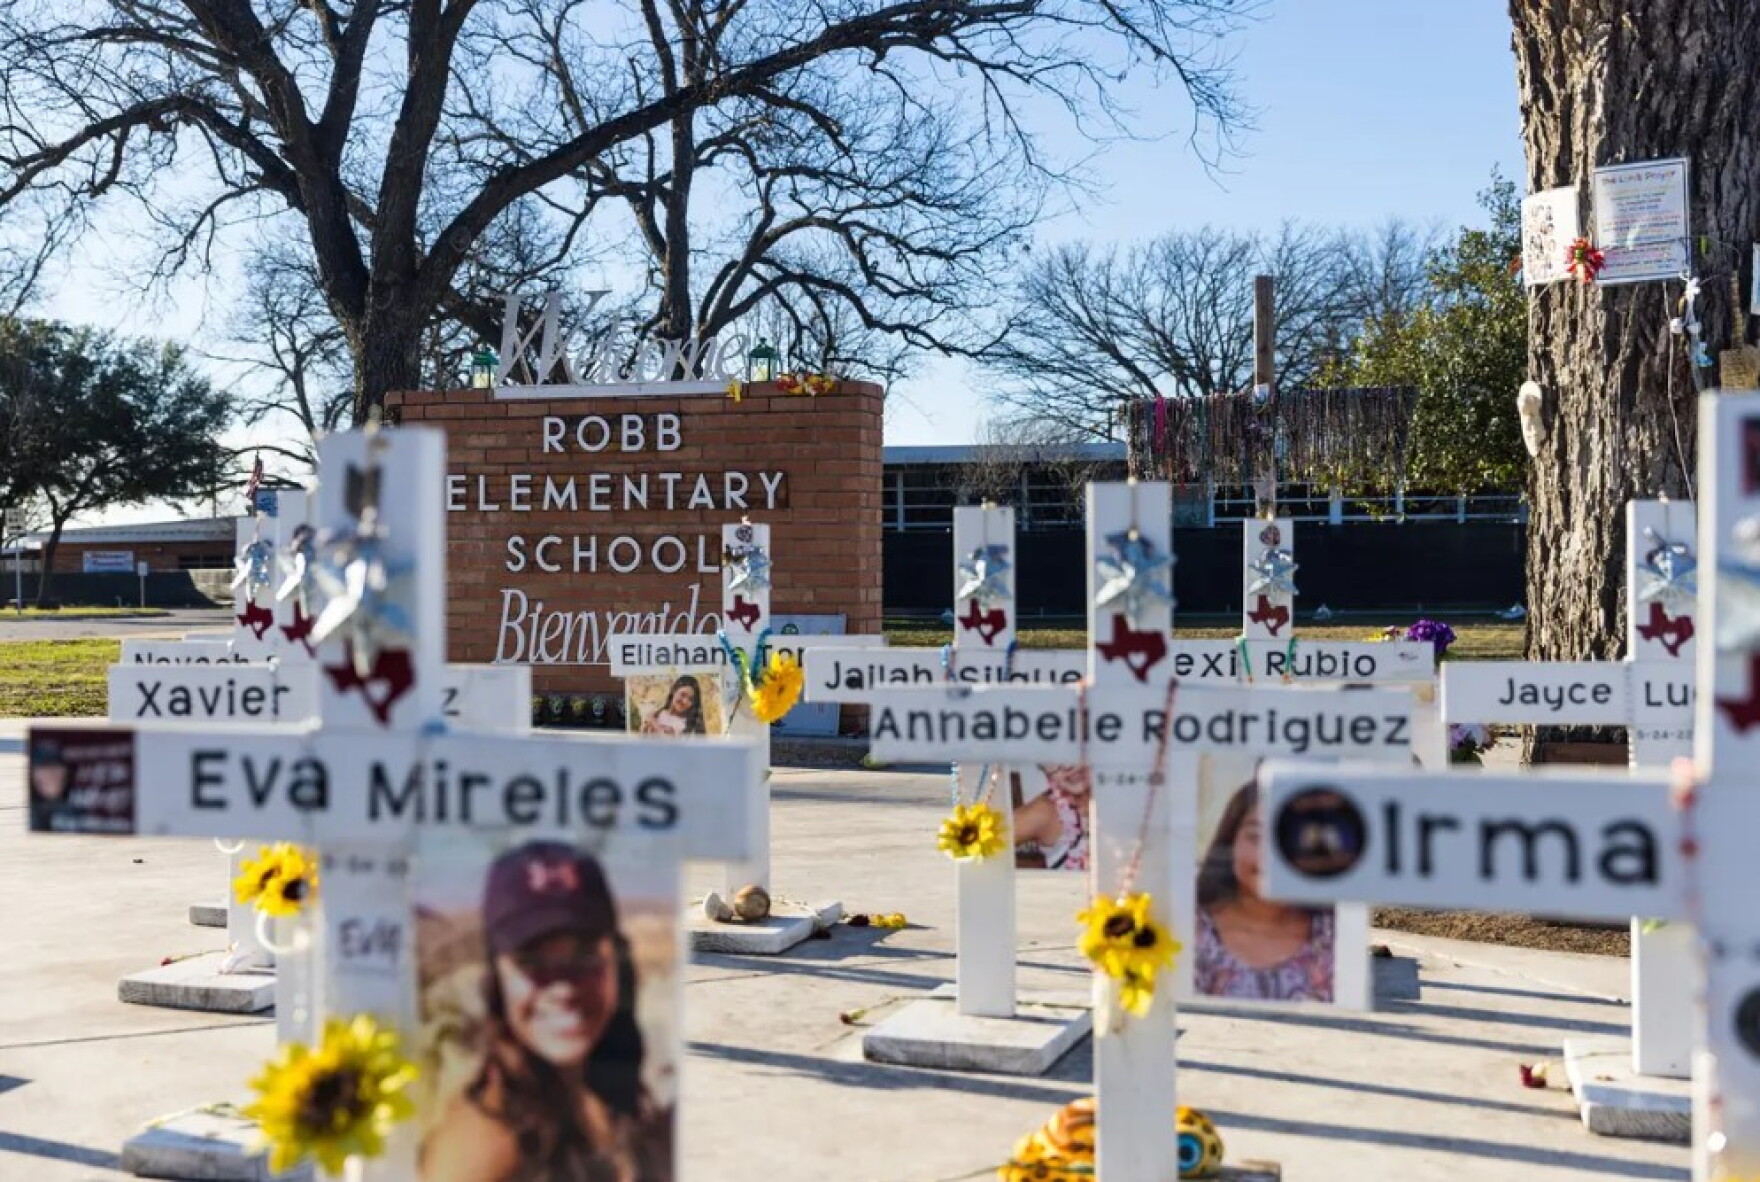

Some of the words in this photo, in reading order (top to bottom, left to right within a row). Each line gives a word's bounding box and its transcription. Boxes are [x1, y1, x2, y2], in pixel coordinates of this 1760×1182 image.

[496, 289, 751, 385] Welcome
[543, 413, 682, 453] ROBB
[446, 472, 785, 511] ELEMENTARY
[506, 535, 720, 573] SCHOOL
[622, 644, 743, 666] Eliahan
[1174, 649, 1237, 677] exi
[1266, 650, 1376, 677] Rubio
[136, 679, 291, 717] Xavier
[1499, 677, 1612, 712] Jayce
[1645, 681, 1697, 708] Lu
[874, 706, 1123, 743] Annabelle
[1142, 710, 1409, 753] Rodriguez
[190, 748, 331, 812] Eva
[367, 760, 680, 831] Mireles
[1381, 800, 1661, 886] Irma
